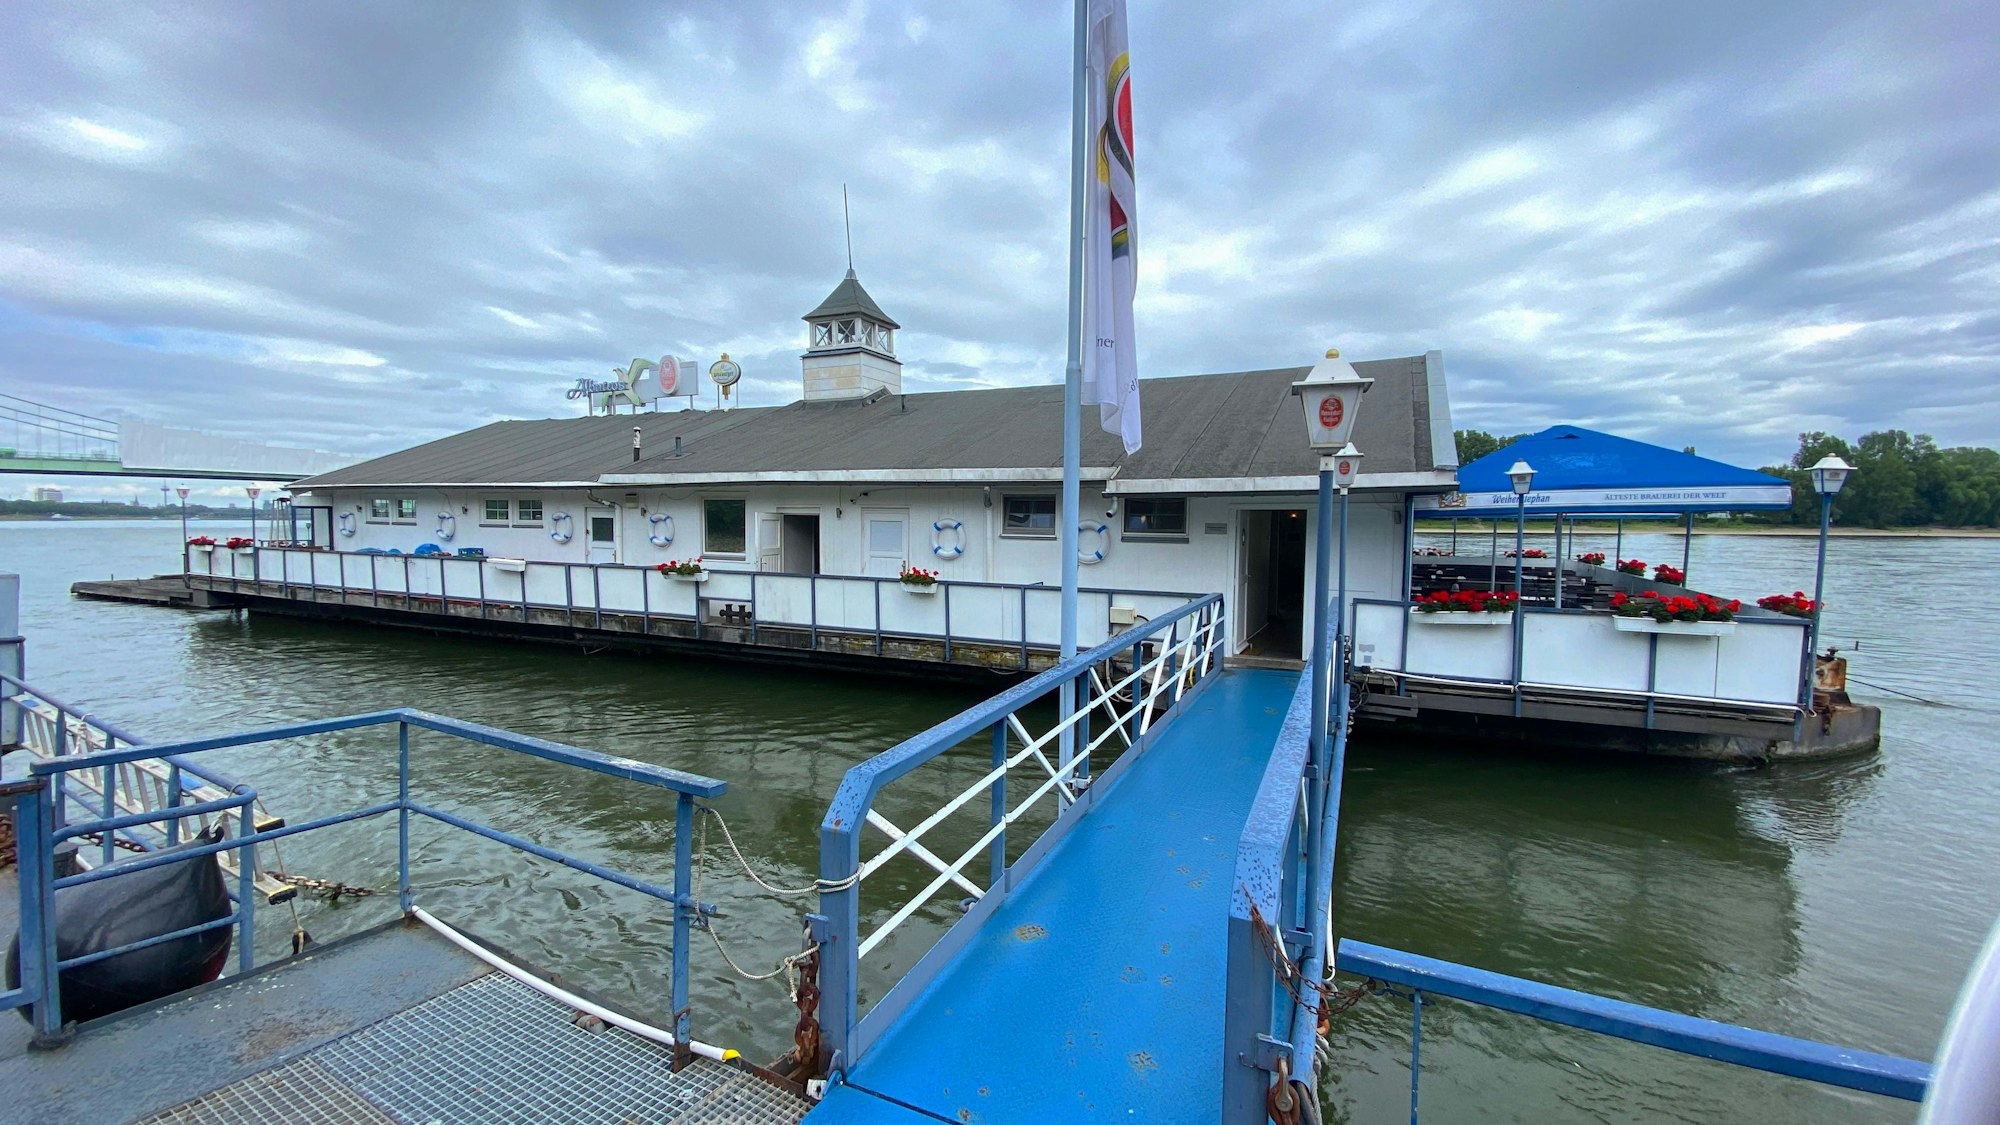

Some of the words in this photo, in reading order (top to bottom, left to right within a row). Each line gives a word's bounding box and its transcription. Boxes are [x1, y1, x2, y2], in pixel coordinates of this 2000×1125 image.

[1096, 336, 1115, 349] ner
[1605, 493, 1639, 501] ÄLTESTE
[1640, 492, 1681, 500] BRAUEREI
[1702, 491, 1727, 499] WELT
